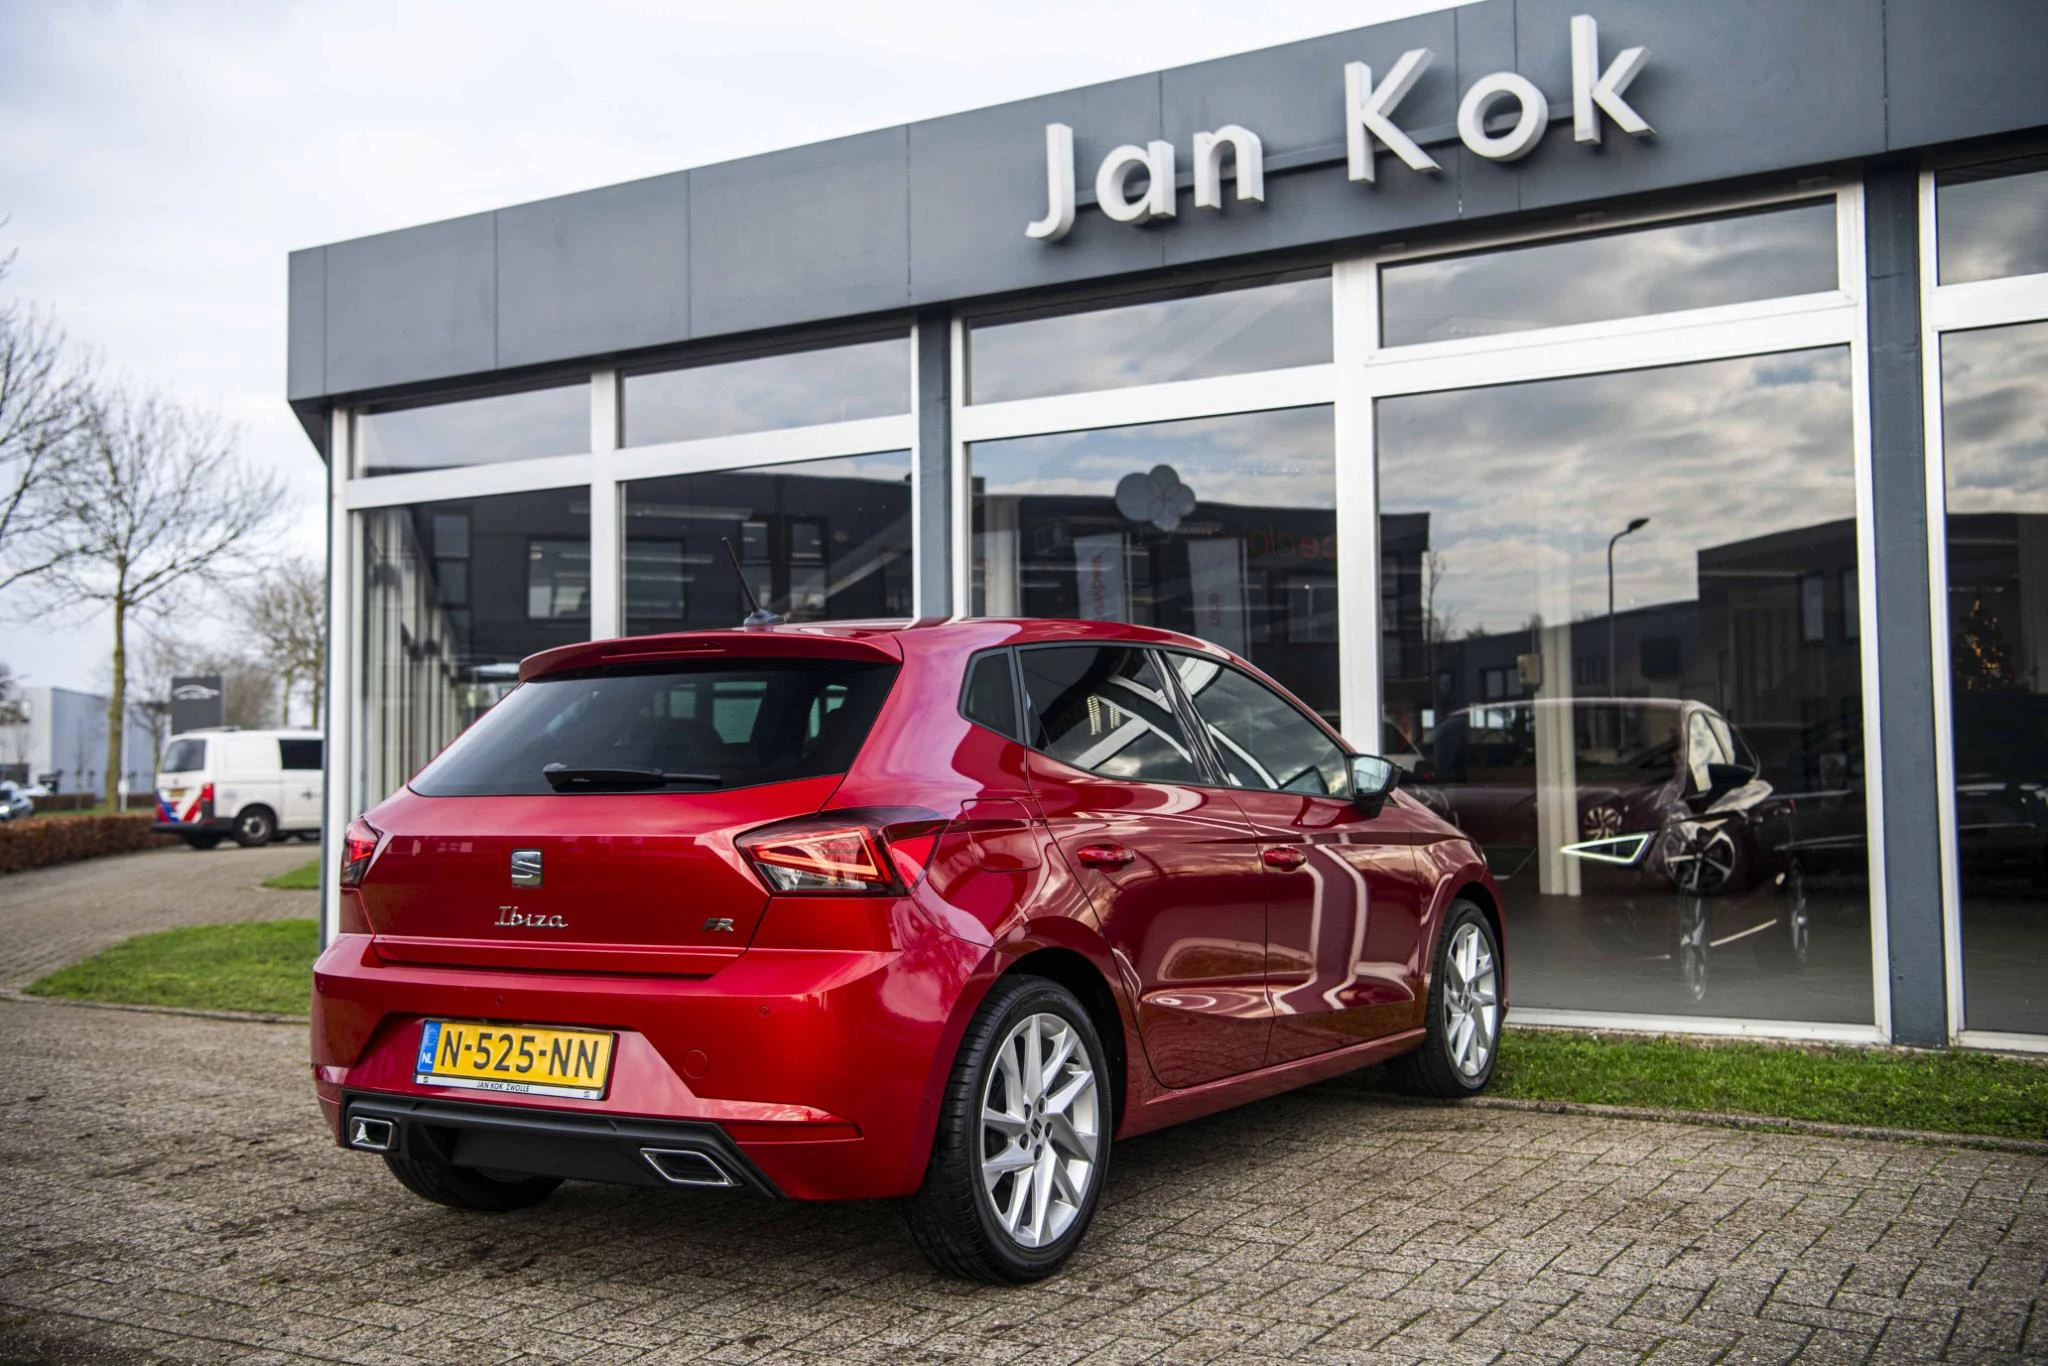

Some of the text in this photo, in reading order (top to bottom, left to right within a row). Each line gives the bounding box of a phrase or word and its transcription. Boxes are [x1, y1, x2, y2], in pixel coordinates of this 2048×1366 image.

[1025, 14, 1656, 242] Jan Kok
[494, 905, 568, 928] Ibiza
[703, 917, 734, 932] FR
[421, 1052, 433, 1064] NL
[440, 1030, 599, 1079] N-525-NN
[476, 1081, 531, 1093] JAN KOK ZWOLLE
